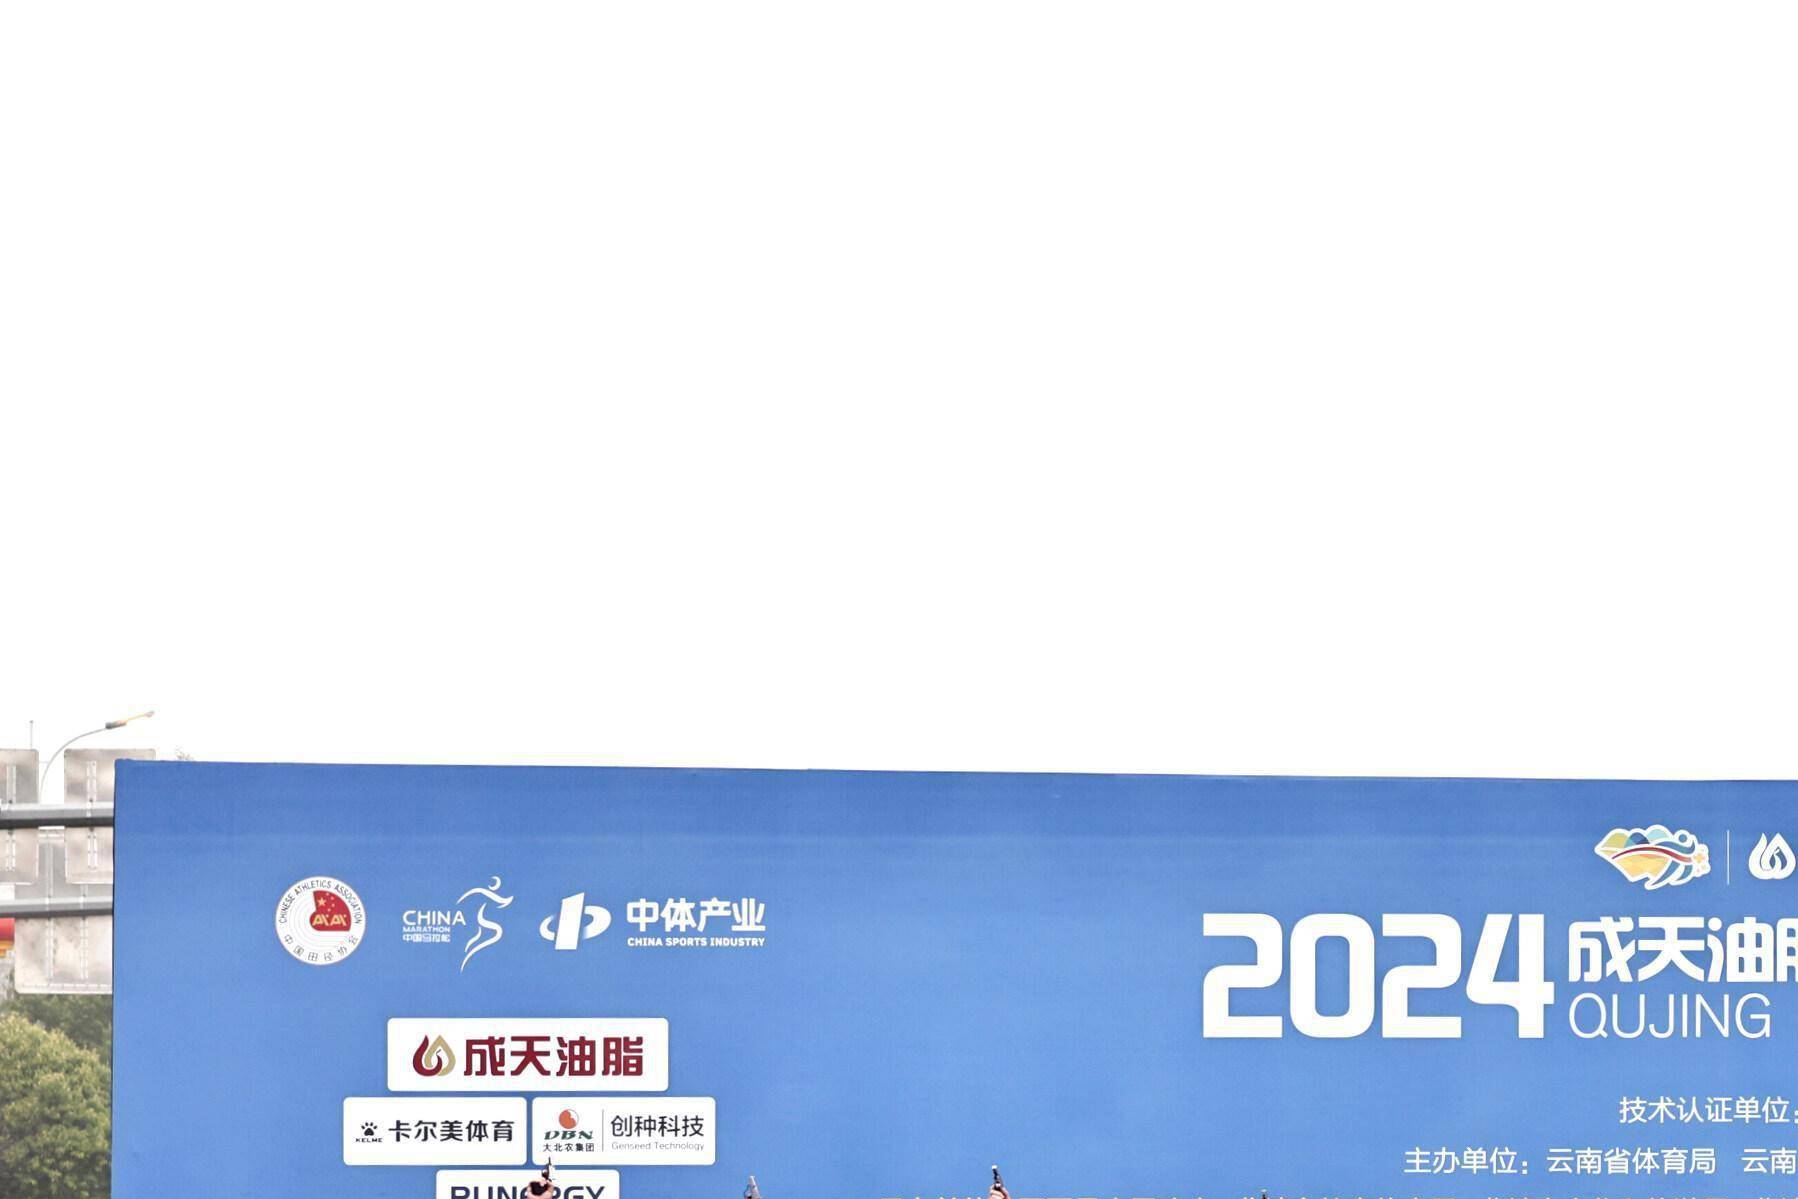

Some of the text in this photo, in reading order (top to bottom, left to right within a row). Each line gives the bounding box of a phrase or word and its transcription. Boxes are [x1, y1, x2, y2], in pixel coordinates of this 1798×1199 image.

[278, 895, 296, 925] CHINESE
[295, 879, 332, 897] ATHLETICS
[402, 910, 467, 926] CHINA
[626, 897, 767, 933] 中体产业
[627, 936, 766, 948] CHINA SPORTS INDUSTRY
[1201, 912, 1552, 1039] 2024
[1569, 992, 1772, 1039] QUJING
[464, 1035, 644, 1077] 成天油脂
[388, 1119, 515, 1142] 卡尔美体育
[544, 1130, 594, 1140] DBN
[610, 1115, 705, 1137] 创种科技
[543, 1143, 595, 1152] 大北农集团
[654, 1141, 705, 1152] Technology
